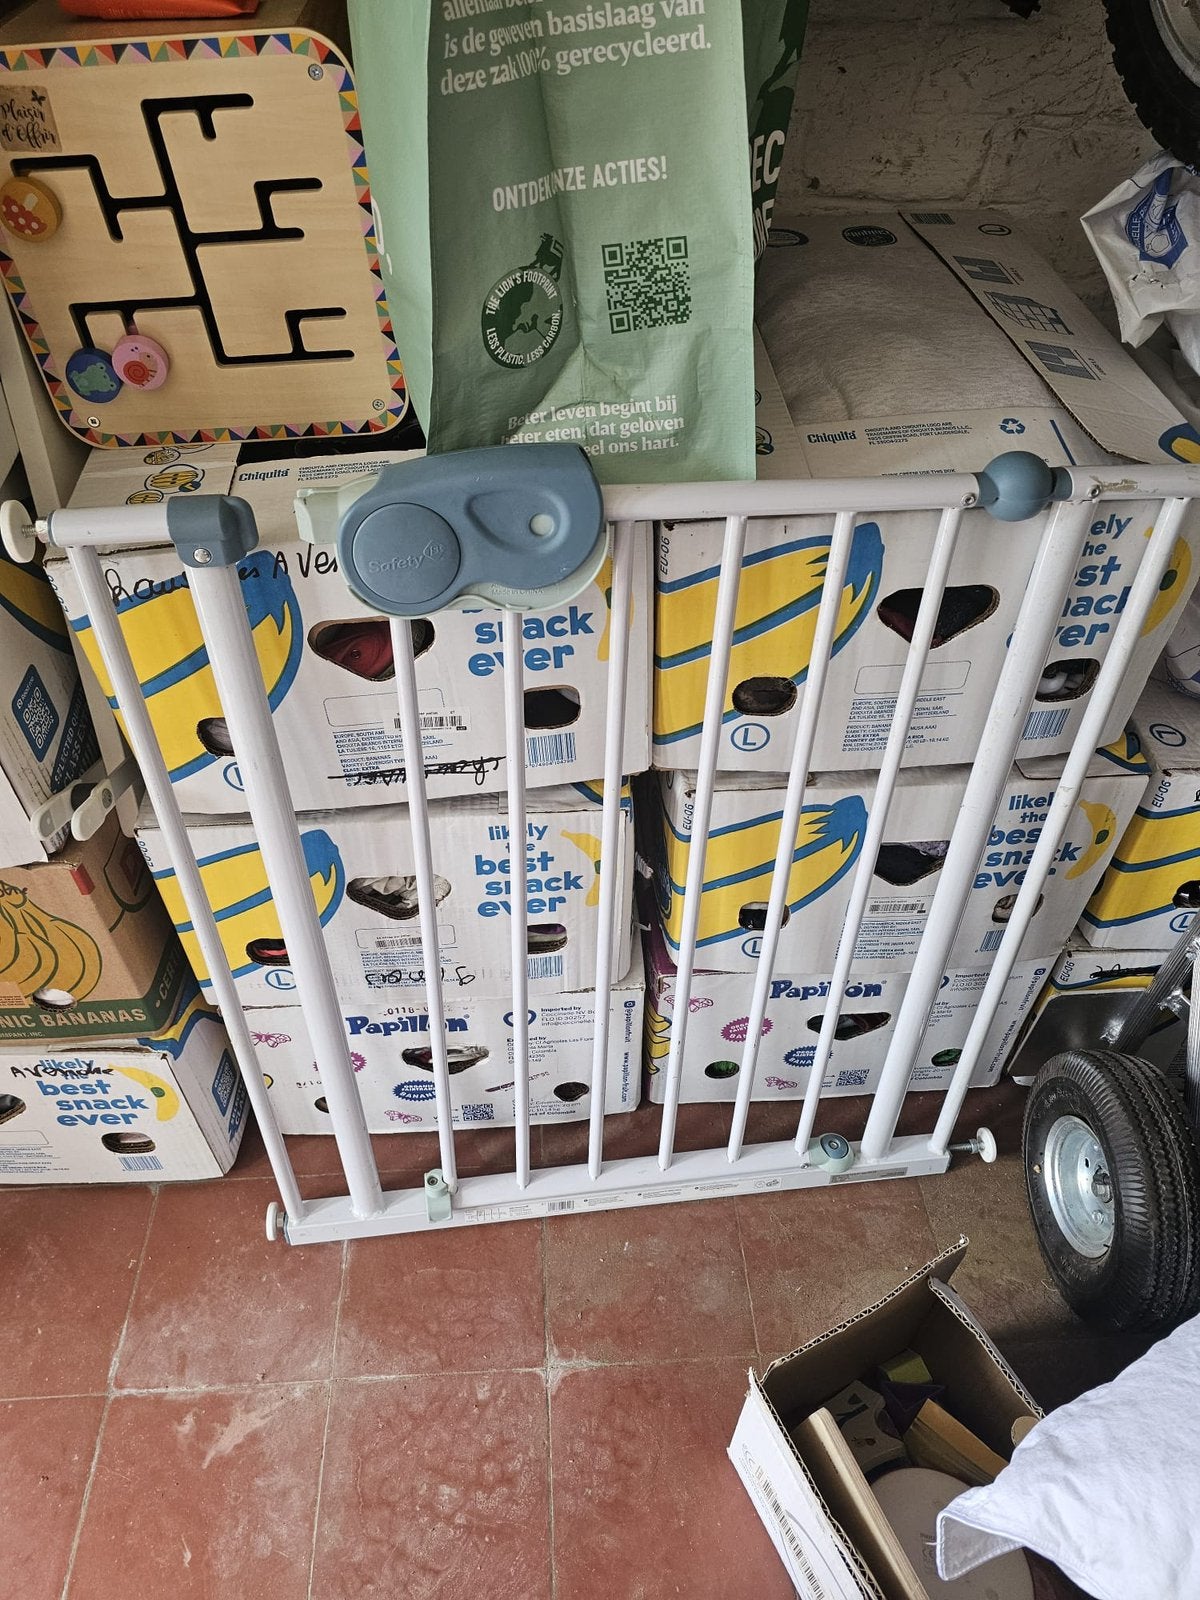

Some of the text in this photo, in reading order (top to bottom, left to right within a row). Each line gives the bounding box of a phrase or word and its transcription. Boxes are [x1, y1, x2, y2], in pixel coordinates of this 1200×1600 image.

[443, 0, 706, 60] is de geweven basislaag van
[440, 24, 712, 96] deze zak 100% gerecycleerd.
[0, 98, 45, 122] Plaisir
[1, 122, 56, 149] d'Offrir
[492, 178, 553, 212] ONTDEK
[592, 155, 668, 190] ACTIES!
[486, 270, 558, 316] THE LION'S FOOTPRINT
[486, 309, 562, 365] LESS PLASTIC. LESS CARBON.
[507, 394, 677, 431] Beter leven begint bij
[545, 427, 587, 442] eten,
[589, 420, 617, 438] dat
[620, 416, 685, 439] geloven
[807, 430, 857, 444] Chiquita
[608, 441, 638, 454] ons
[641, 436, 680, 452] hart.
[238, 468, 291, 482] Chiquita
[659, 536, 671, 576] EU-06
[1081, 541, 1107, 557] he
[272, 551, 288, 579] A
[368, 554, 424, 573] Safety
[1151, 778, 1173, 809] EU-06
[681, 803, 695, 832] EU-06
[488, 822, 549, 842] likly
[1060, 959, 1075, 983] EU-06
[39, 1008, 147, 1028] BANANAS
[345, 1014, 469, 1037] Papilln
[36, 1079, 112, 1096] best
[56, 1095, 150, 1111] snack
[56, 1112, 140, 1127] ever
